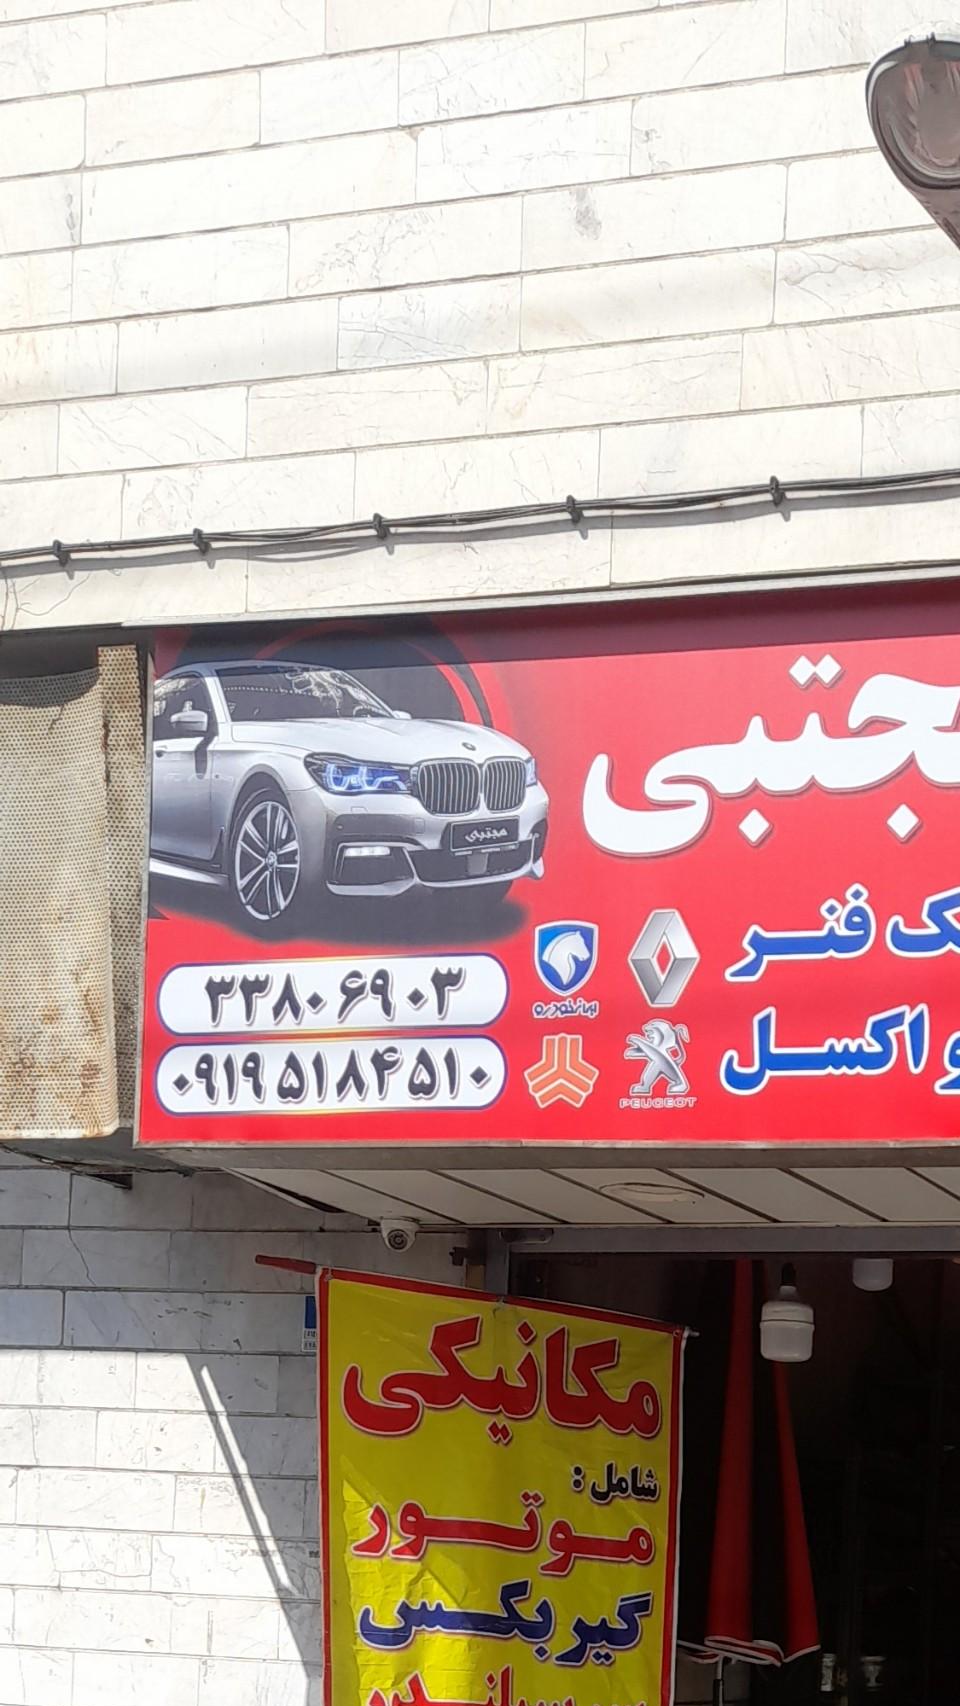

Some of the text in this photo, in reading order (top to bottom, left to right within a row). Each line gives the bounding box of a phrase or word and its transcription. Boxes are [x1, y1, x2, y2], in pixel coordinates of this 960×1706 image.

[464, 827, 508, 843] مجتبی
[725, 883, 876, 981] فنر
[720, 1004, 929, 1093] اکسل
[619, 1097, 697, 1109] PEUGEOT
[342, 1316, 661, 1446] مکانیکی
[352, 1491, 655, 1576] موتور
